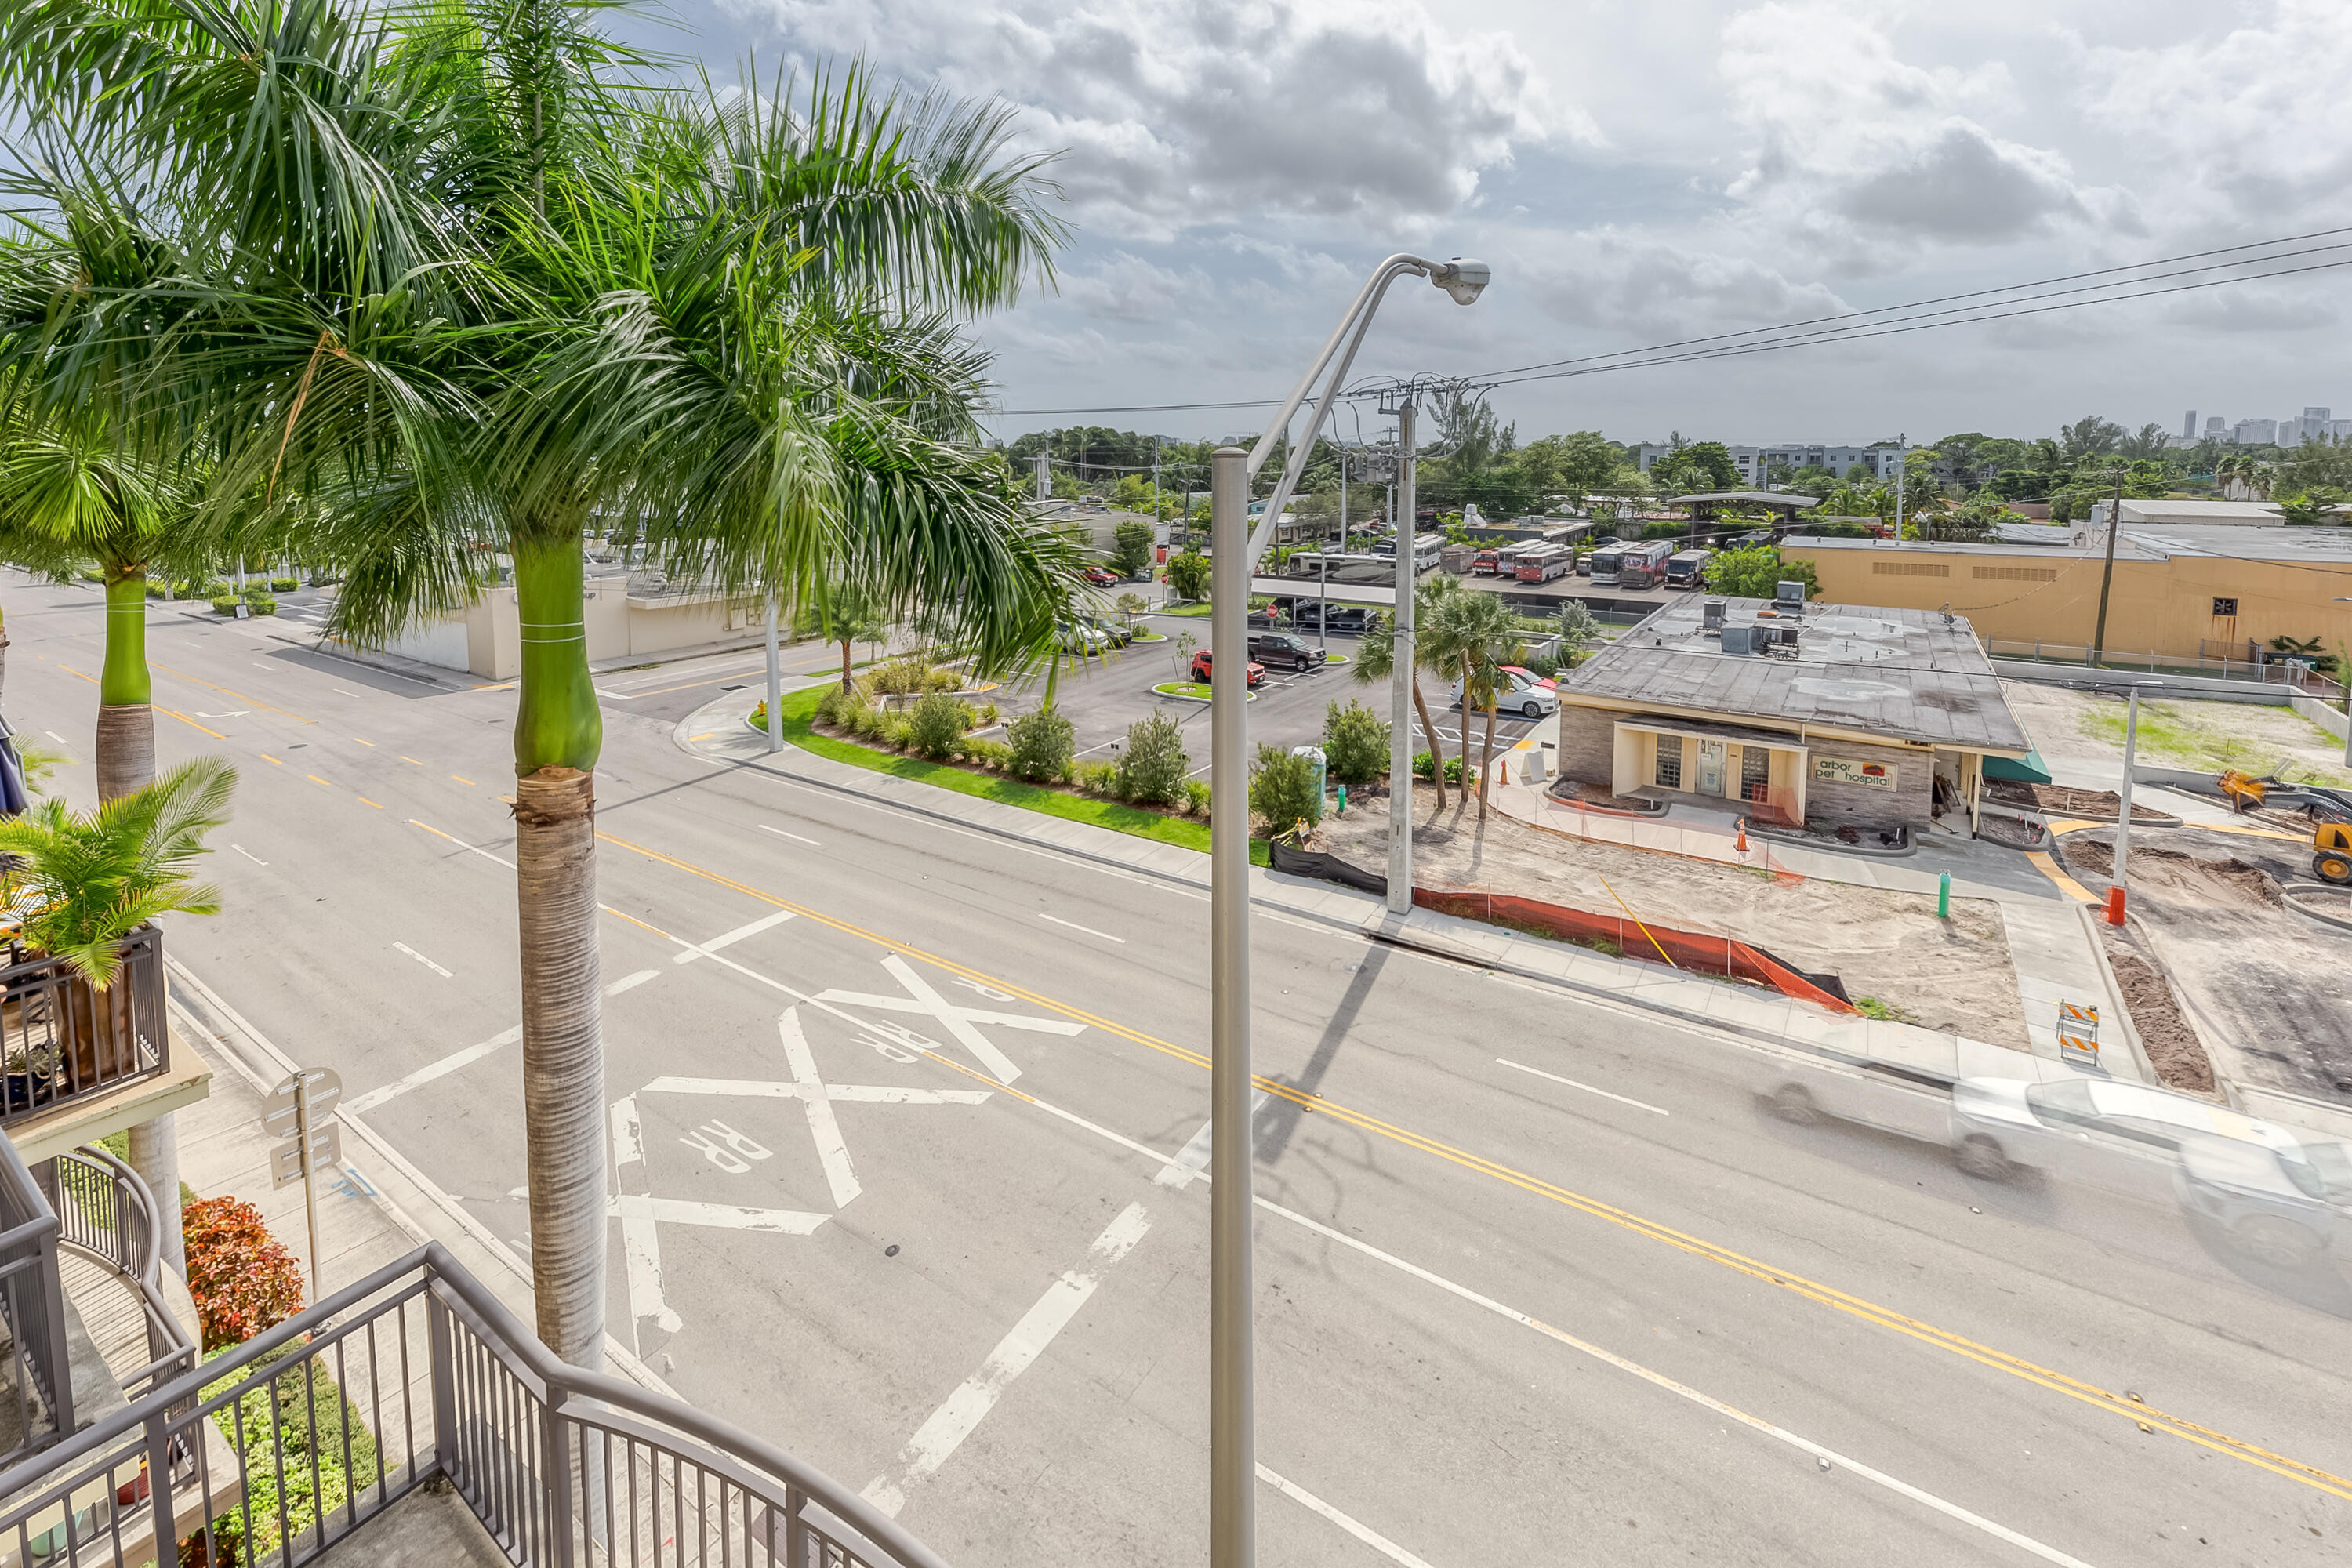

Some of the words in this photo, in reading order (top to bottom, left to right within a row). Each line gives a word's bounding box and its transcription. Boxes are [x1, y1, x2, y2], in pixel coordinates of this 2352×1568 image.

[1820, 760, 1851, 771] arbor
[1815, 770, 1835, 779] pet
[1845, 771, 1890, 786] hospital
